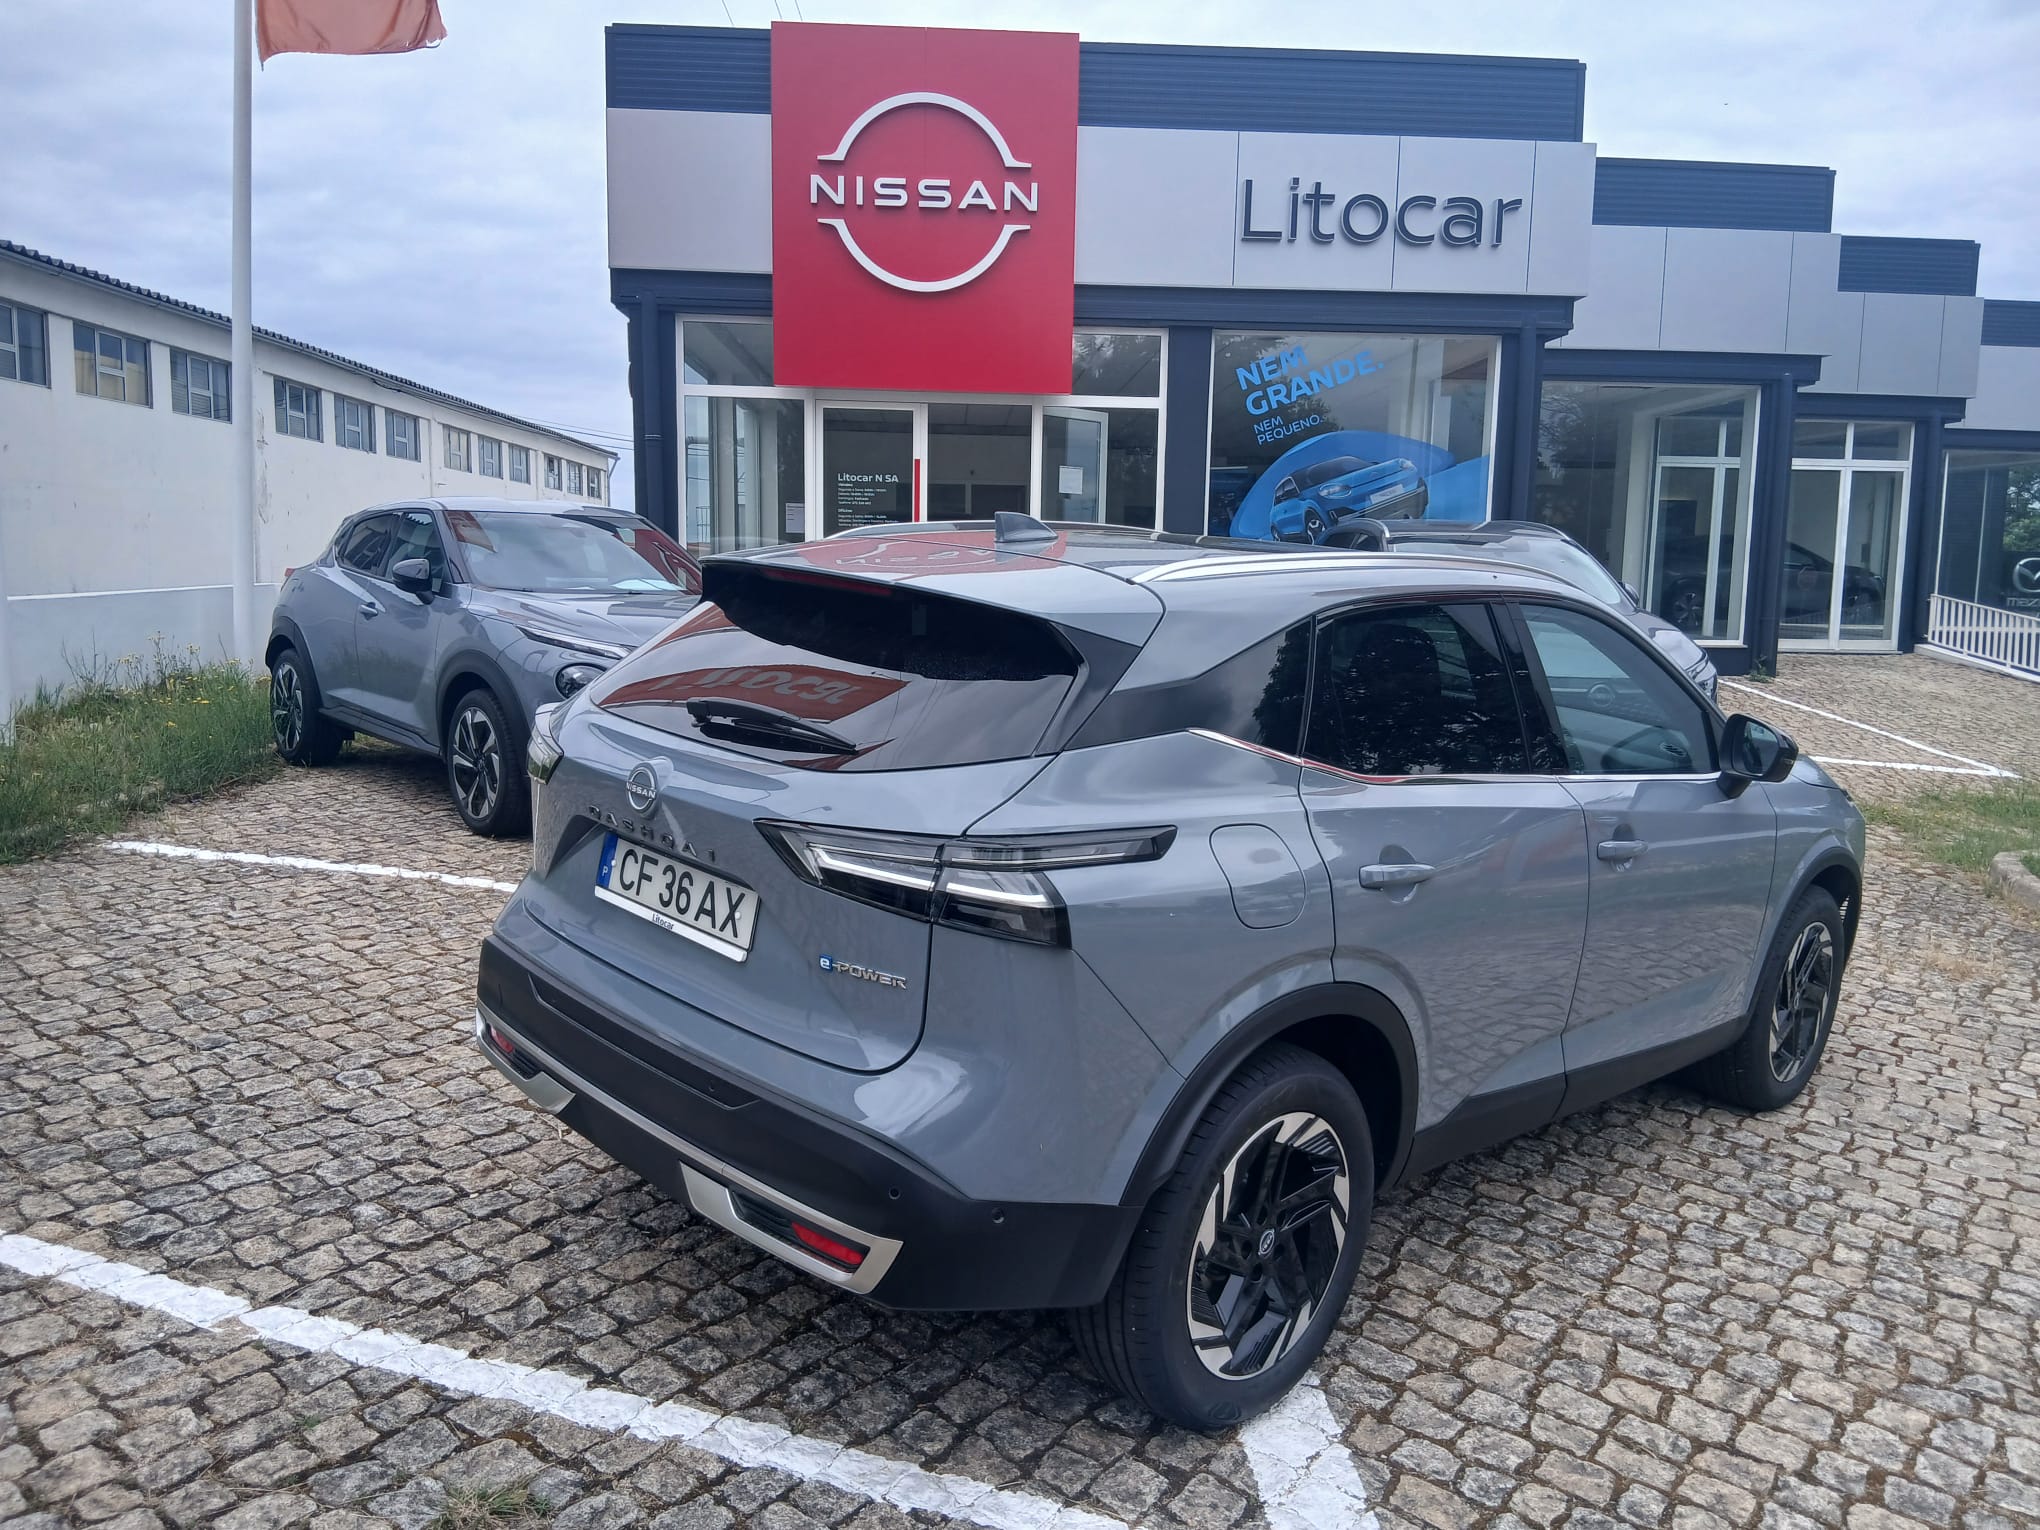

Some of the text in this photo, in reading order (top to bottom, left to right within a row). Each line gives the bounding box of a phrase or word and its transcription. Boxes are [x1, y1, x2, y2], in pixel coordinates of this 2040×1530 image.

[810, 174, 1038, 212] NISSAN
[1241, 177, 1523, 248] Litocar
[1235, 343, 1310, 391] NEM
[1245, 350, 1384, 416] GRANDE.
[1253, 415, 1283, 434] NEM
[1257, 414, 1324, 445] PEQUENO.
[837, 472, 899, 483] Litocar N SA
[626, 781, 656, 799] NISSAN
[601, 866, 609, 877] P
[652, 912, 675, 931] Litocar
[819, 957, 907, 990] e-POWER
